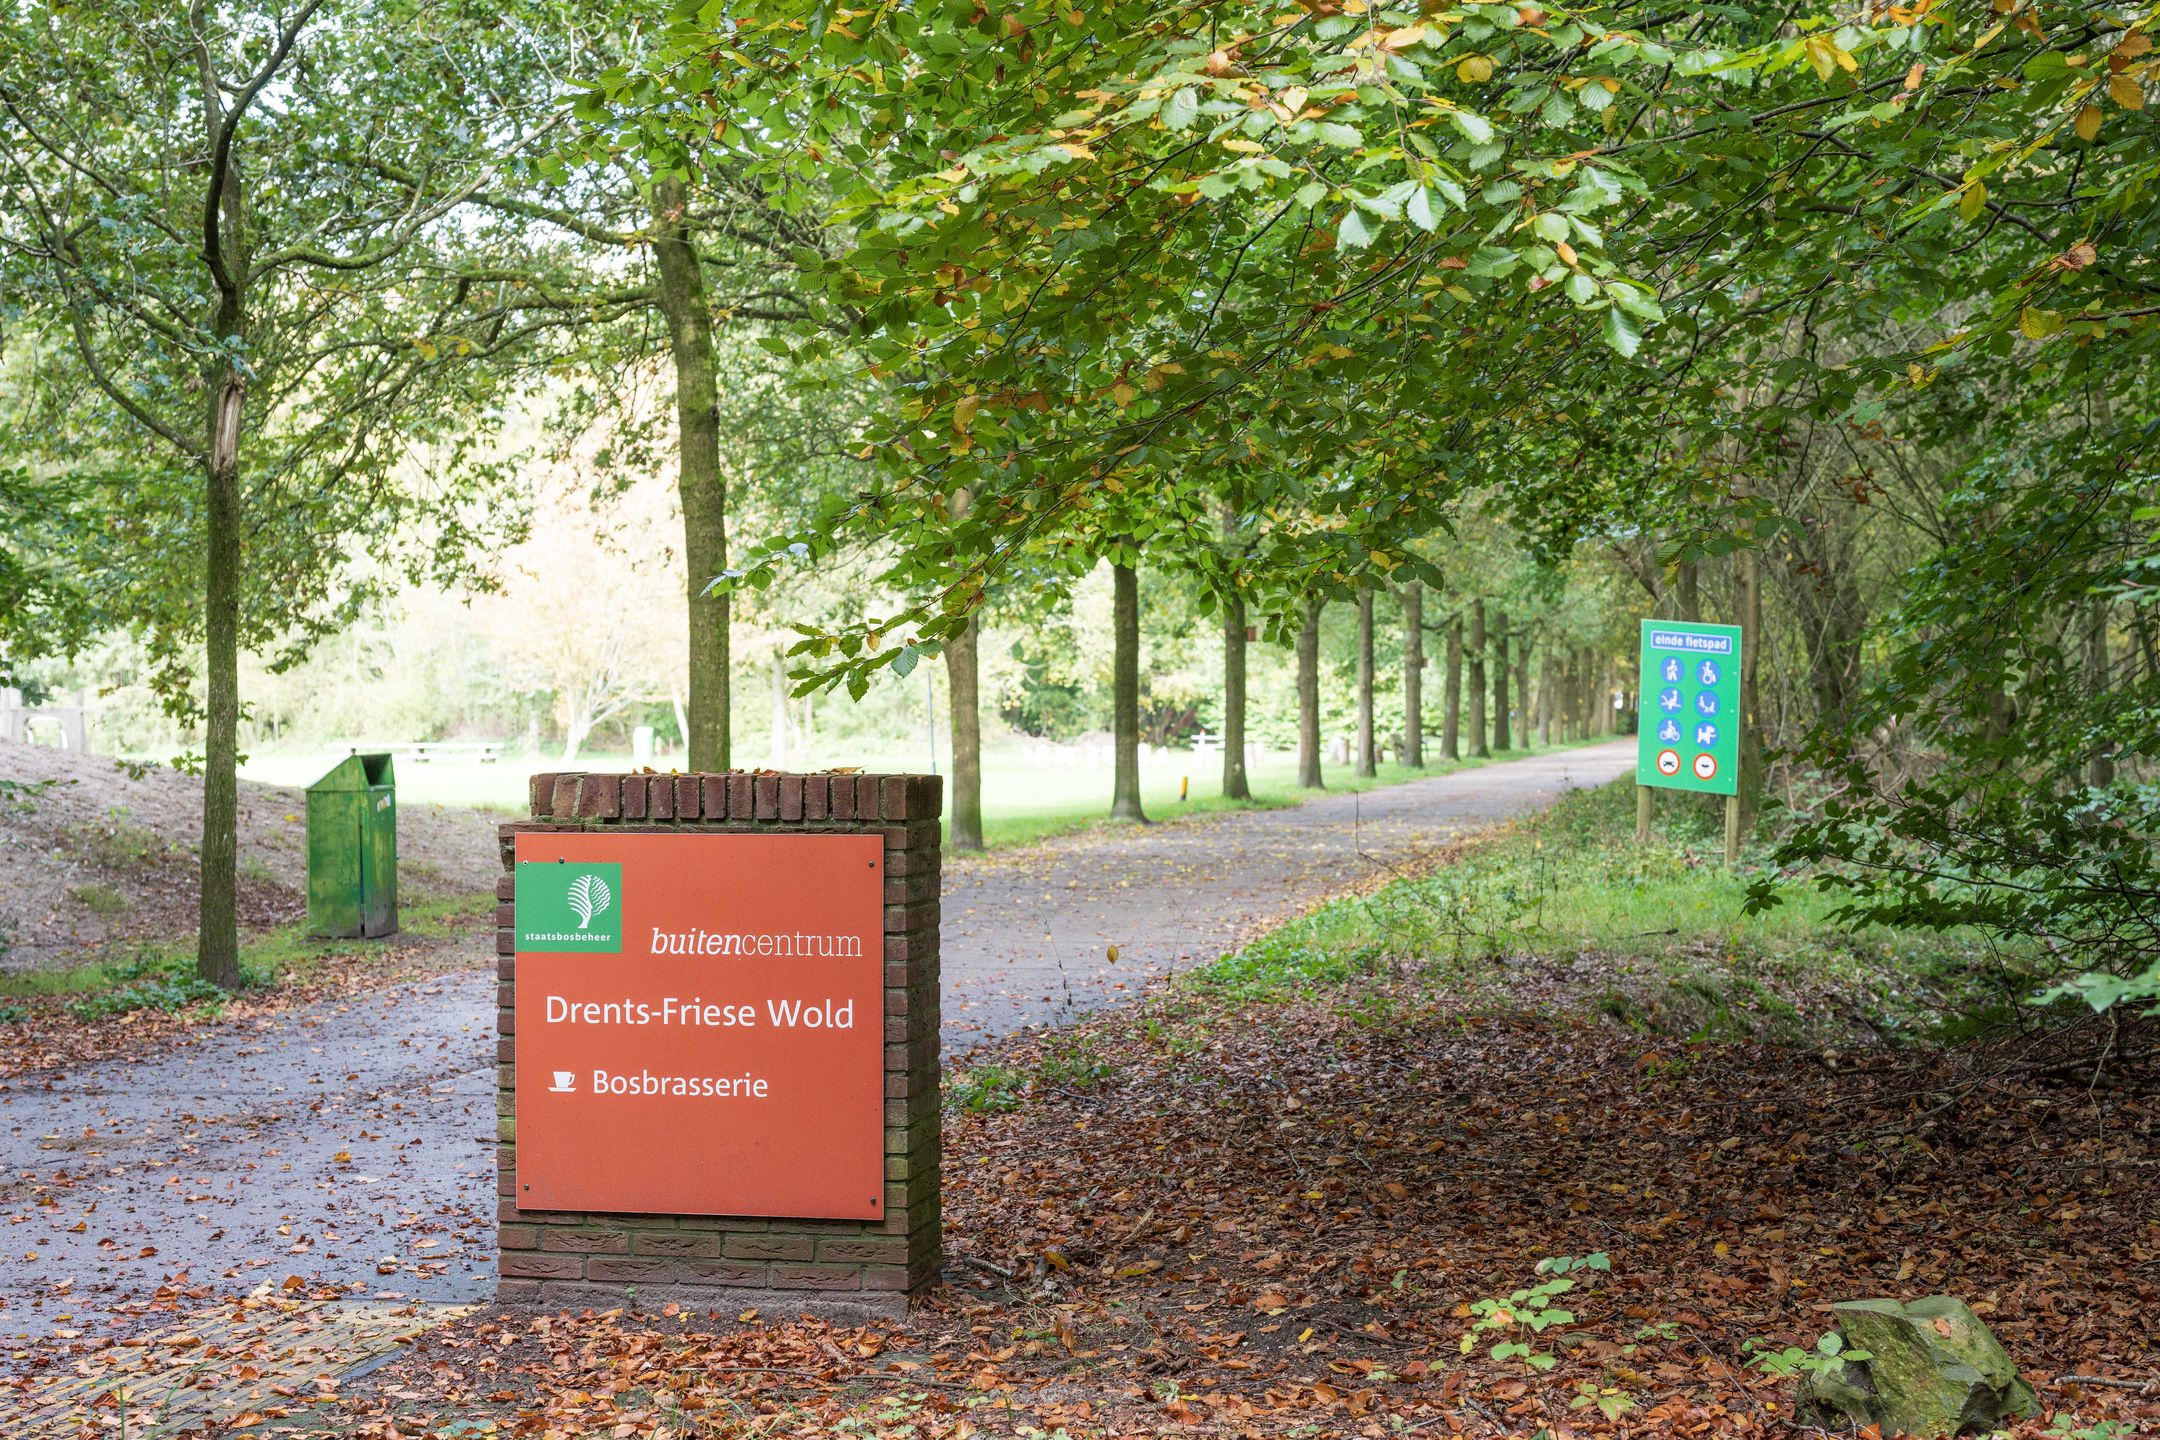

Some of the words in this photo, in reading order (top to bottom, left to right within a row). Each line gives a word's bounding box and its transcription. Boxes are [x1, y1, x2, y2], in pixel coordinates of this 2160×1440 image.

[1655, 634, 1683, 647] einde
[1685, 636, 1727, 651] fietspad
[525, 931, 611, 943] staatsbosbeheer
[650, 927, 863, 958] buitencentrum
[545, 995, 756, 1028] Drents-Friese
[767, 999, 854, 1029] Wold
[592, 1069, 769, 1098] Bosbrasserie
